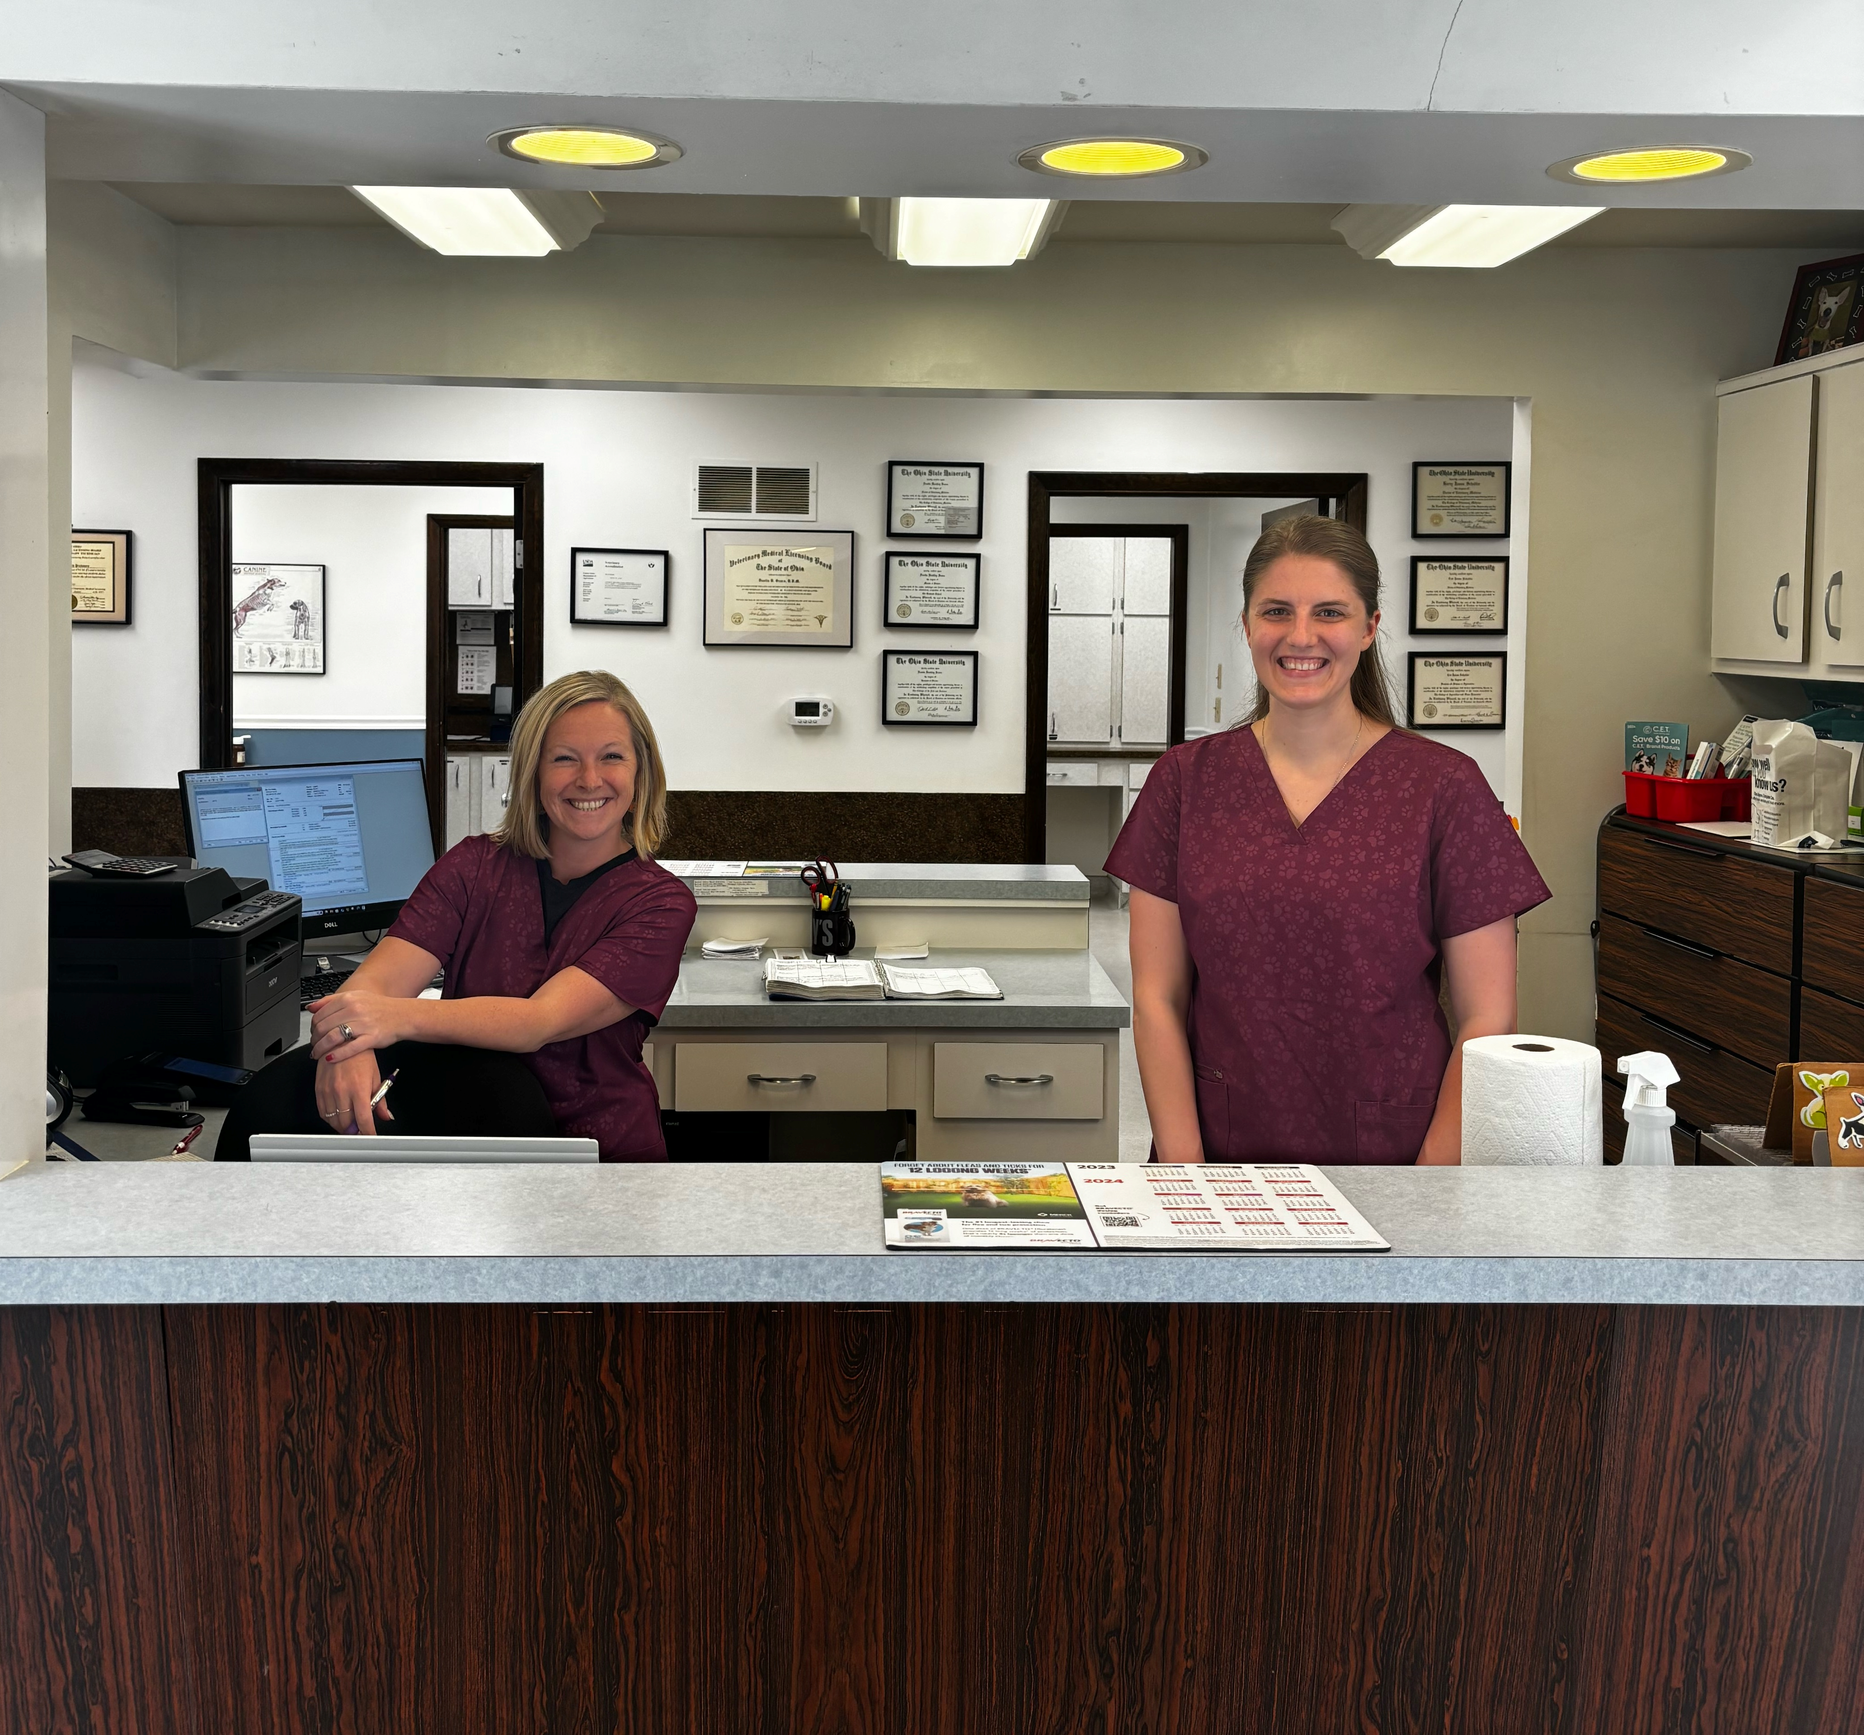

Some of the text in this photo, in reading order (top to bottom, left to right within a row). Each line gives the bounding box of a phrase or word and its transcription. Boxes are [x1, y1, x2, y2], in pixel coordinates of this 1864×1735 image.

[913, 469, 926, 477] Ohio
[944, 470, 971, 478] University
[1467, 470, 1496, 478] University
[761, 550, 784, 558] Medical
[784, 548, 814, 562] Licensing
[814, 556, 832, 570] Board
[756, 563, 767, 571] The
[898, 560, 908, 568] The
[941, 560, 968, 569] University
[1426, 564, 1437, 572] The
[1438, 564, 1452, 572] Ohio
[1468, 564, 1495, 572] University
[896, 657, 906, 665] The
[939, 658, 966, 666] University
[1424, 660, 1434, 668] The
[1436, 660, 1449, 668] Ohio
[1465, 660, 1492, 668] University
[1632, 735, 1654, 743] Save
[1655, 735, 1669, 744] $10
[1754, 775, 1786, 792] know us?
